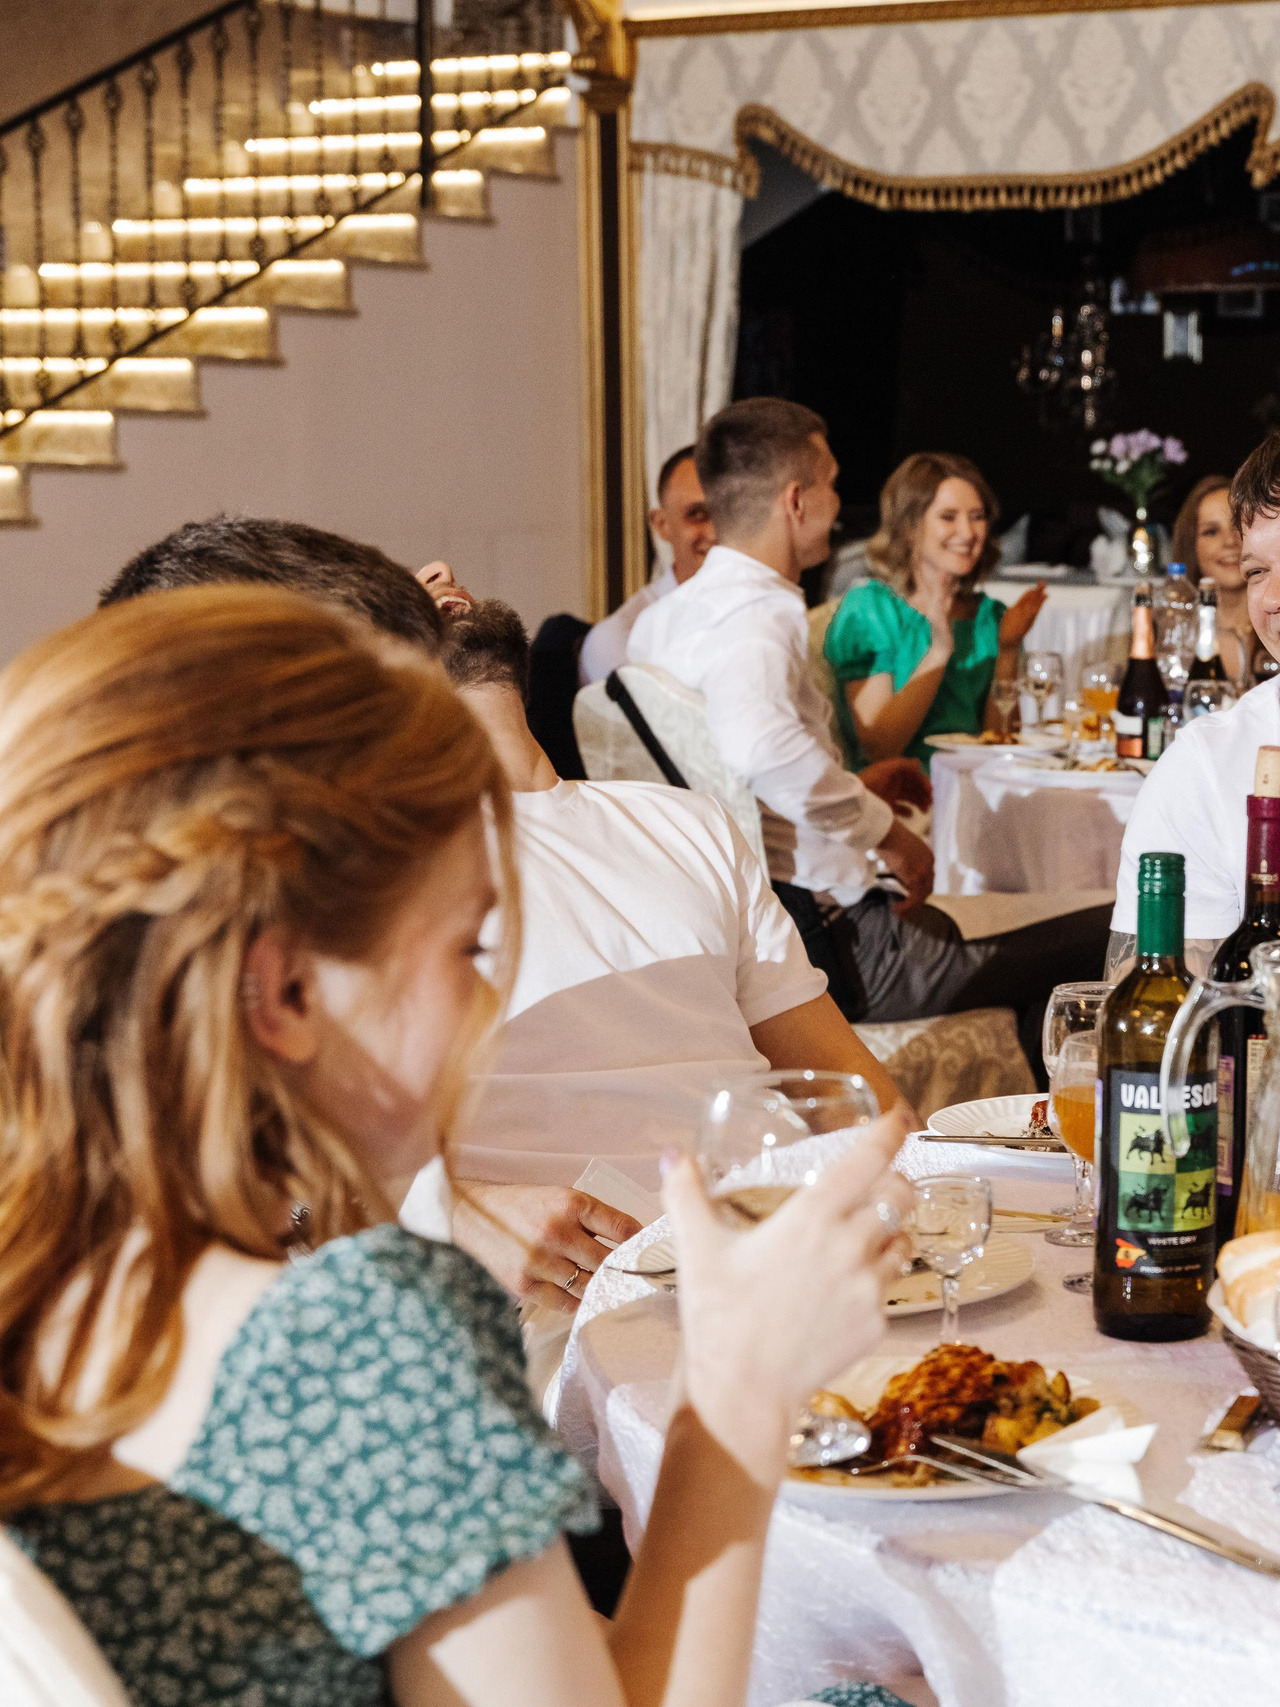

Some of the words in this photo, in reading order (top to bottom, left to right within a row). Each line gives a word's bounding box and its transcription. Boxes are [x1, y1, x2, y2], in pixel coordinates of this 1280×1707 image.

[1120, 1082, 1218, 1110] VALESOL
[1147, 1236, 1179, 1245] WHITE
[1179, 1235, 1198, 1245] DRY
